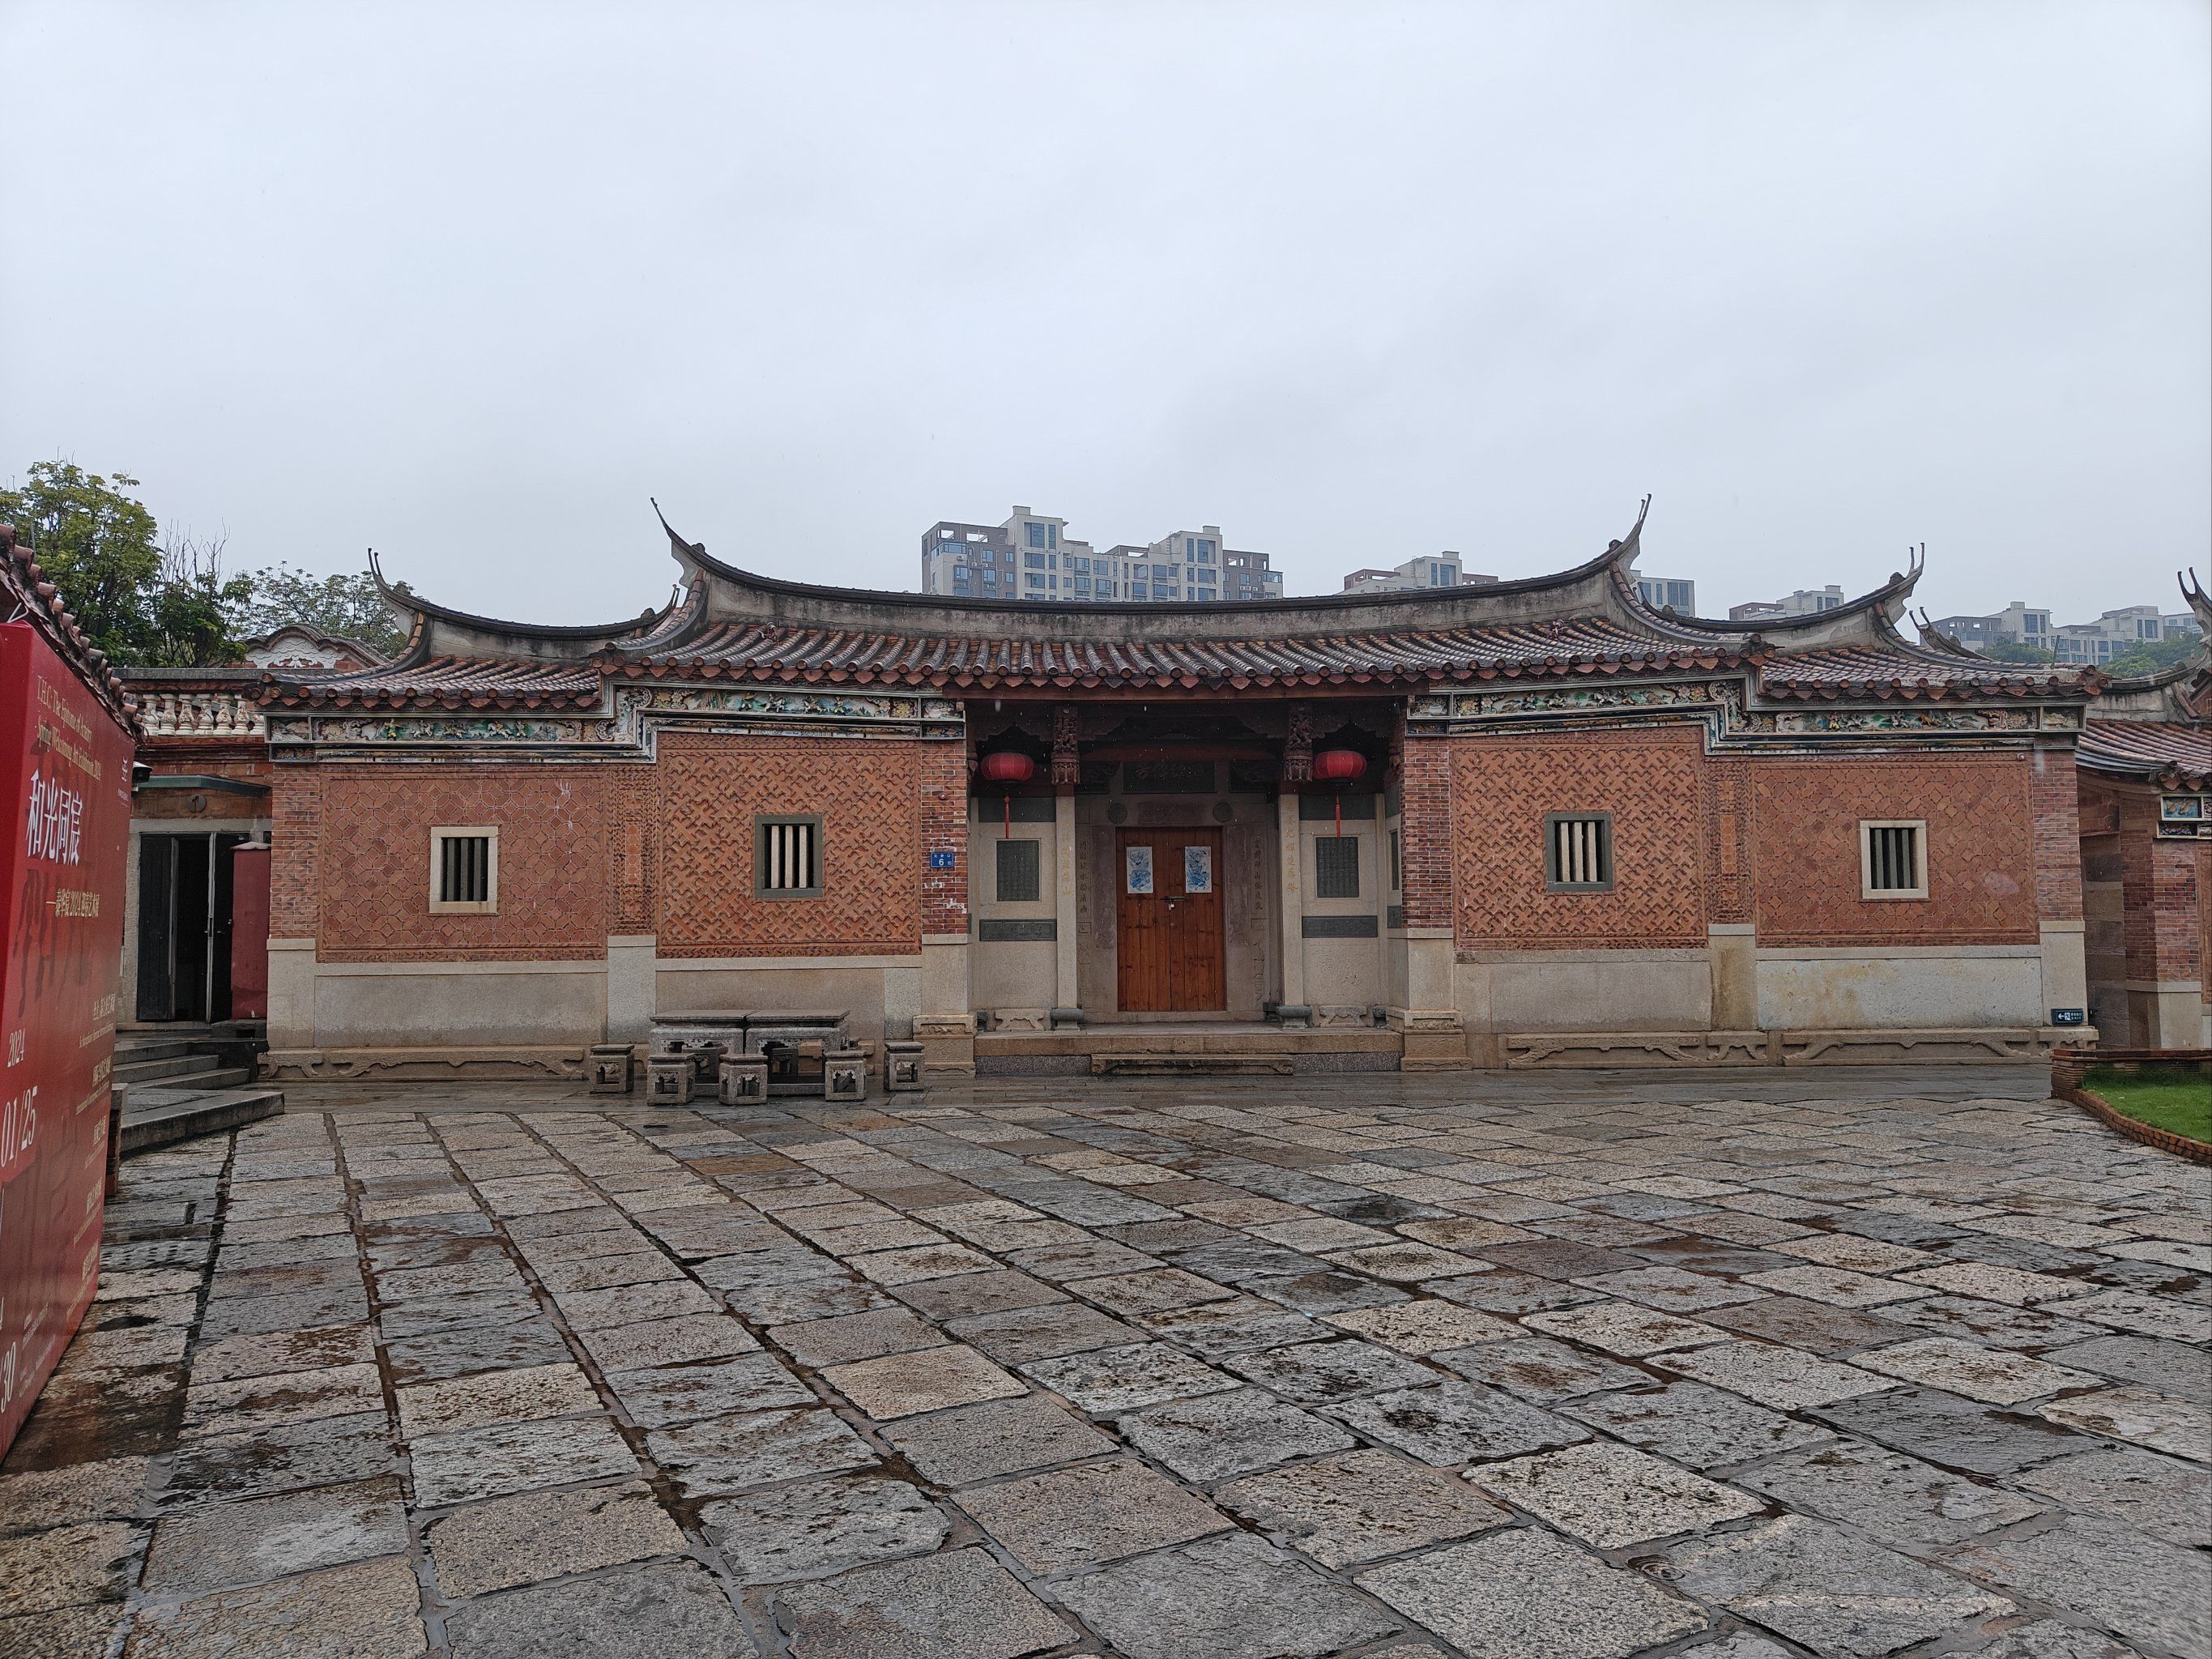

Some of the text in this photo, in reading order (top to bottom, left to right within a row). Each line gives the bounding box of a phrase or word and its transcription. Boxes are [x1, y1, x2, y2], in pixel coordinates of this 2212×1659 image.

[53, 688, 61, 718] The
[25, 767, 83, 867] 和光同宸
[939, 858, 944, 866] 6
[6, 1028, 25, 1068] 2024
[1, 1085, 37, 1168] 01/25
